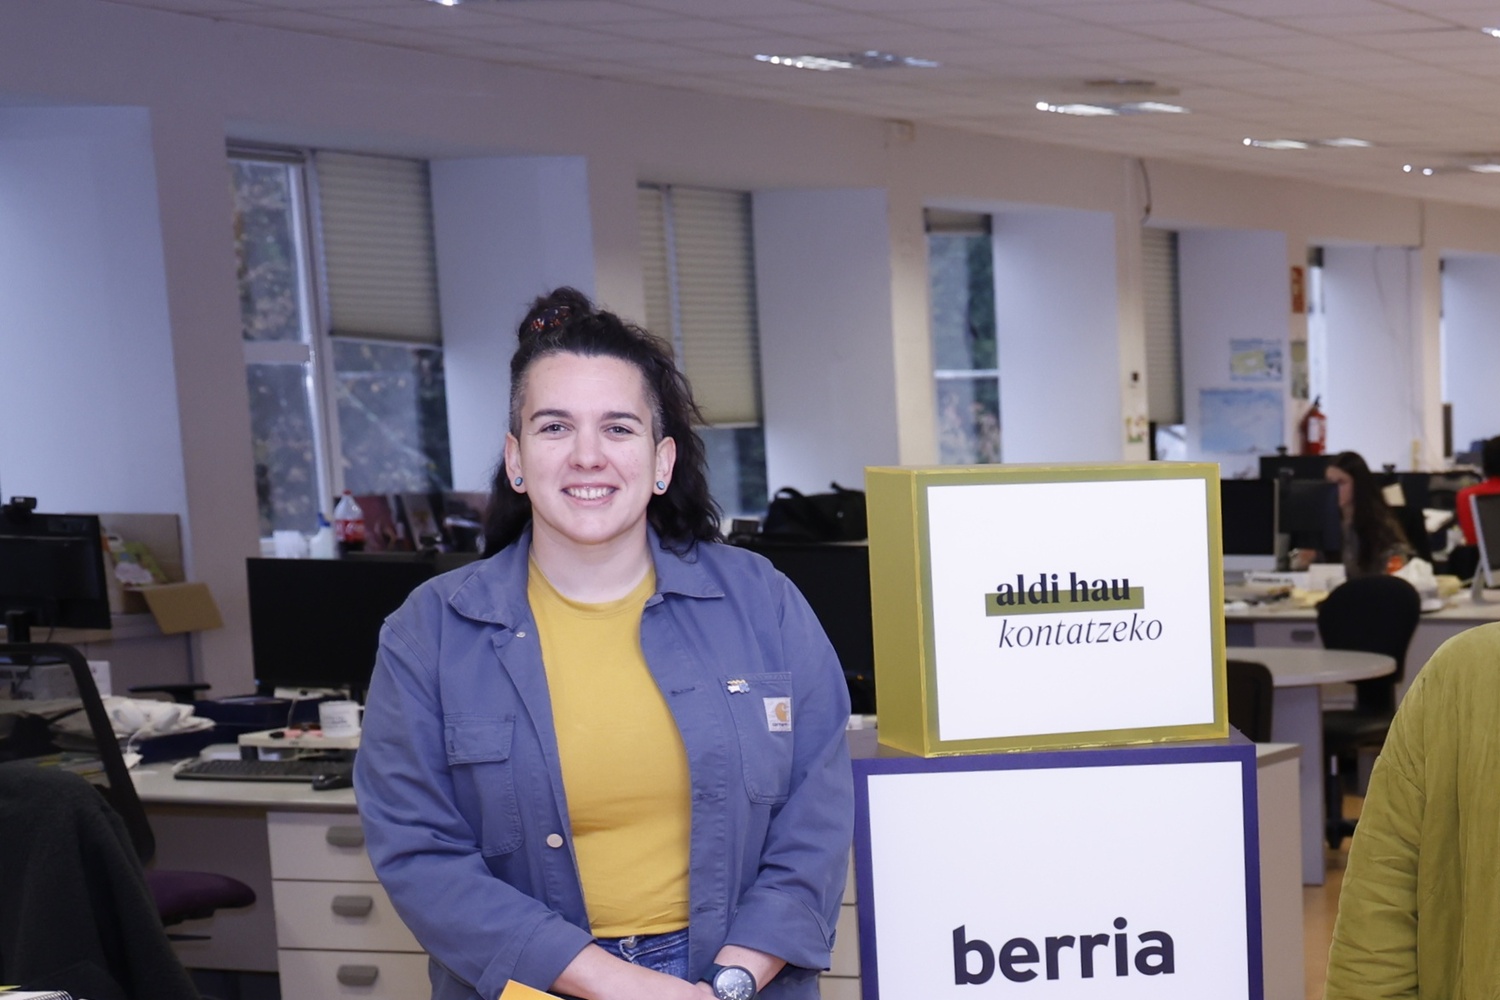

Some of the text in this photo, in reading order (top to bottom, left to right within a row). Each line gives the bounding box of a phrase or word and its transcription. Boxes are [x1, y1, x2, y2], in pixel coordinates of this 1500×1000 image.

[996, 571, 1131, 606] aldi hau
[999, 612, 1163, 649] kontatzeko
[952, 916, 1175, 985] berria
